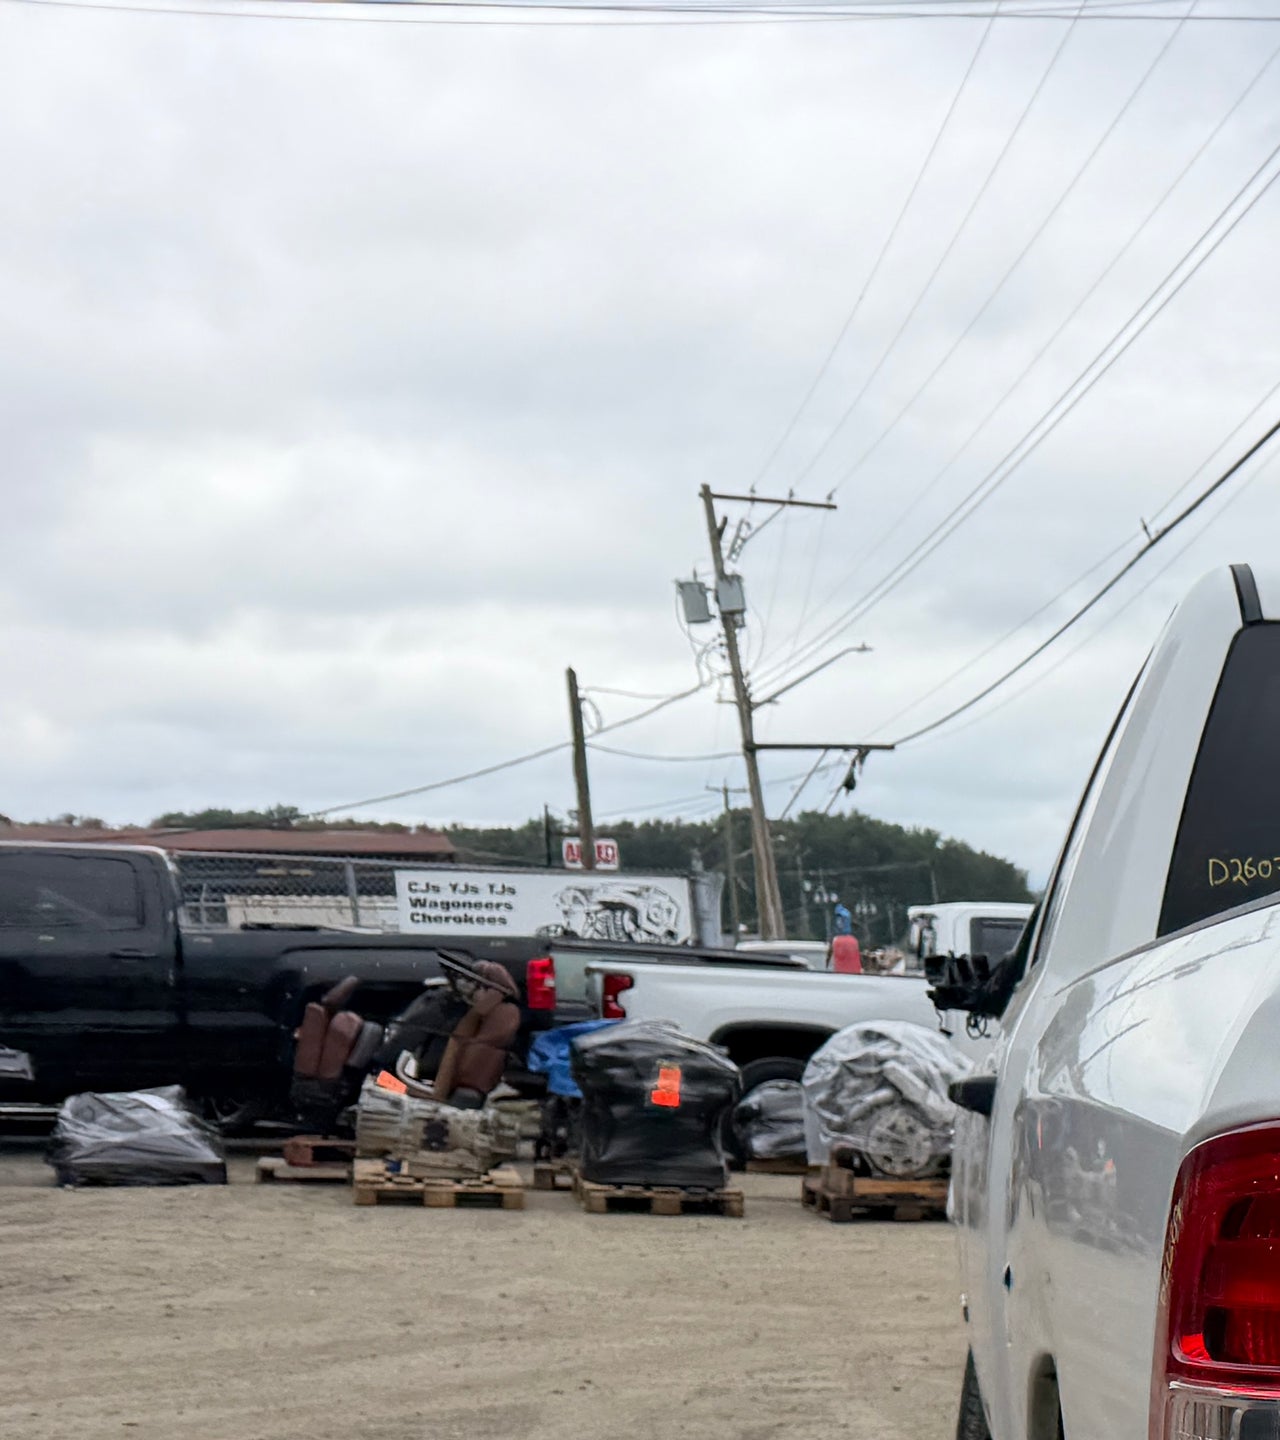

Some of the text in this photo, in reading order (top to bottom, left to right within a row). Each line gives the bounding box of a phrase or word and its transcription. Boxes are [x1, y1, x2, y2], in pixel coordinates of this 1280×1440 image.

[407, 880, 441, 894] CJs
[408, 896, 514, 912] Wagoneers
[409, 912, 508, 925] Cherokees
